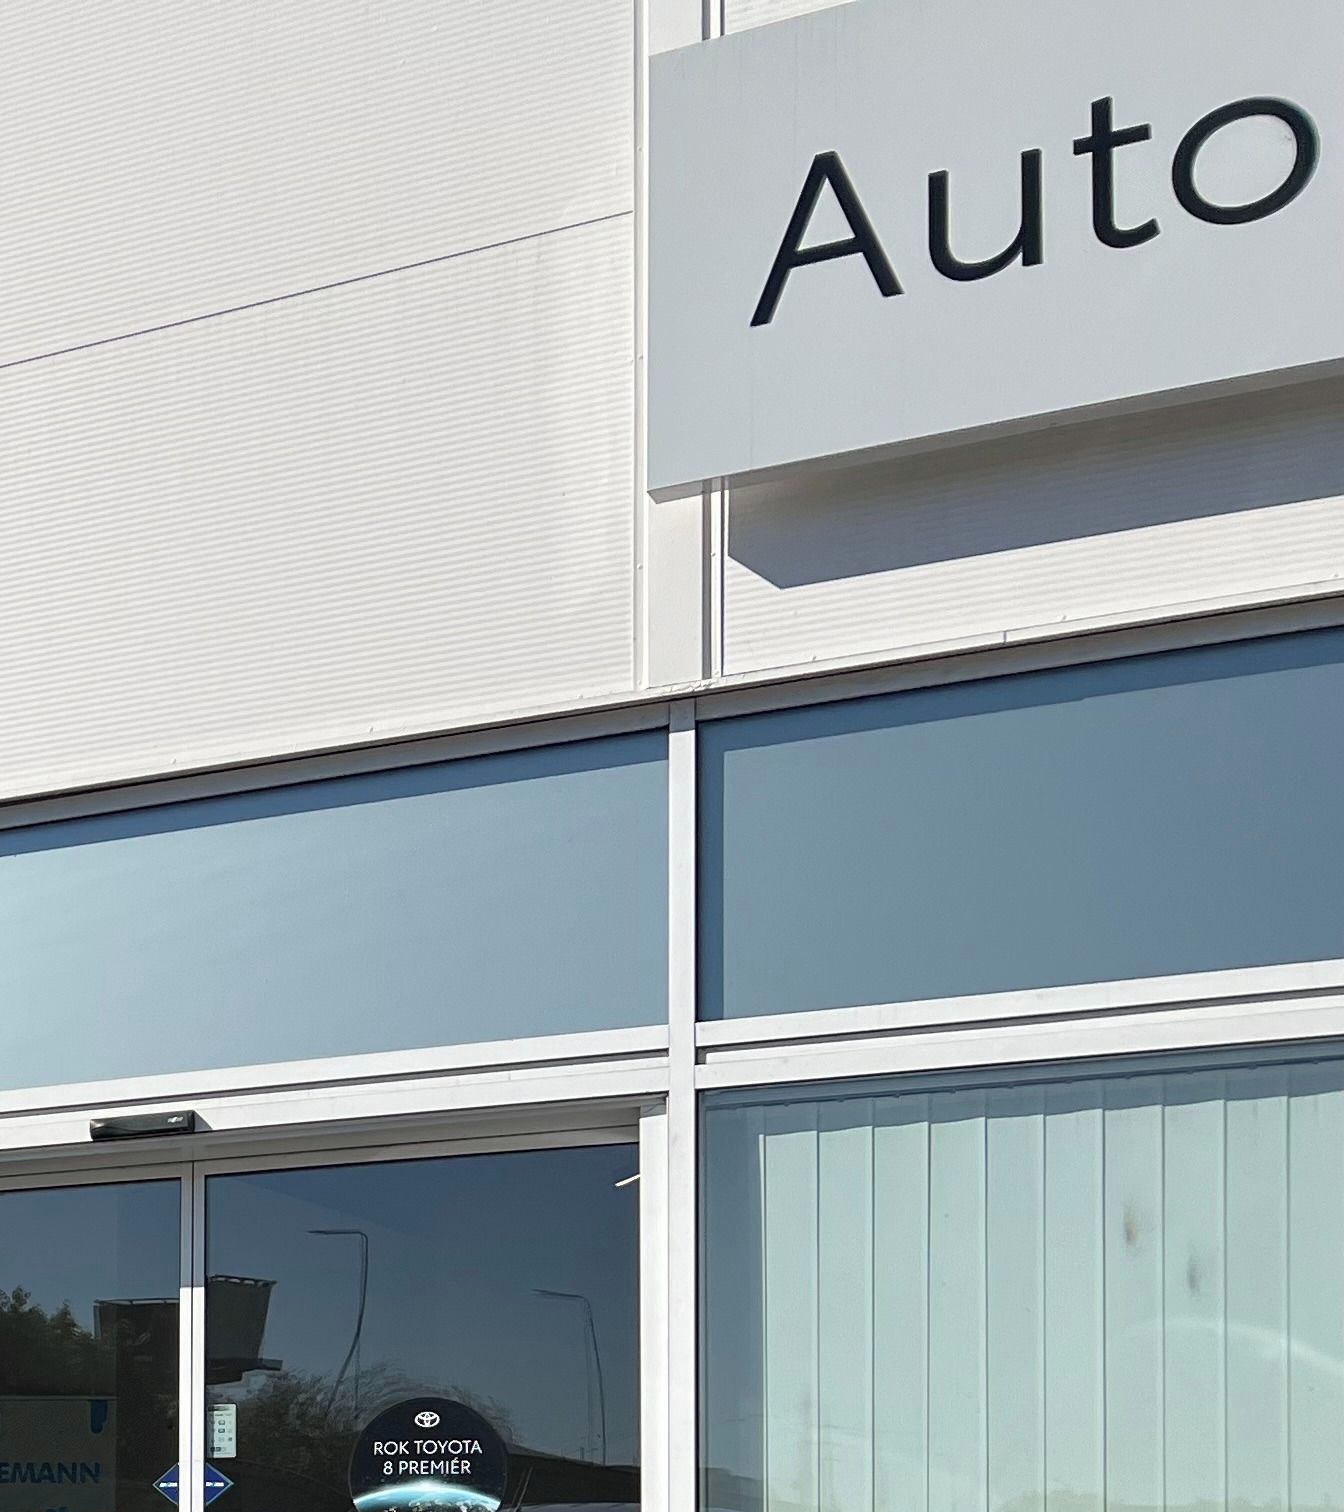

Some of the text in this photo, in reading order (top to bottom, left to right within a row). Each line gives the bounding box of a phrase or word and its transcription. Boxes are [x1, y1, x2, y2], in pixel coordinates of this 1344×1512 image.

[749, 95, 1321, 328] Auto
[373, 1439, 483, 1456] ROK TOYOTA
[382, 1457, 472, 1475] 8 PREMIÉR
